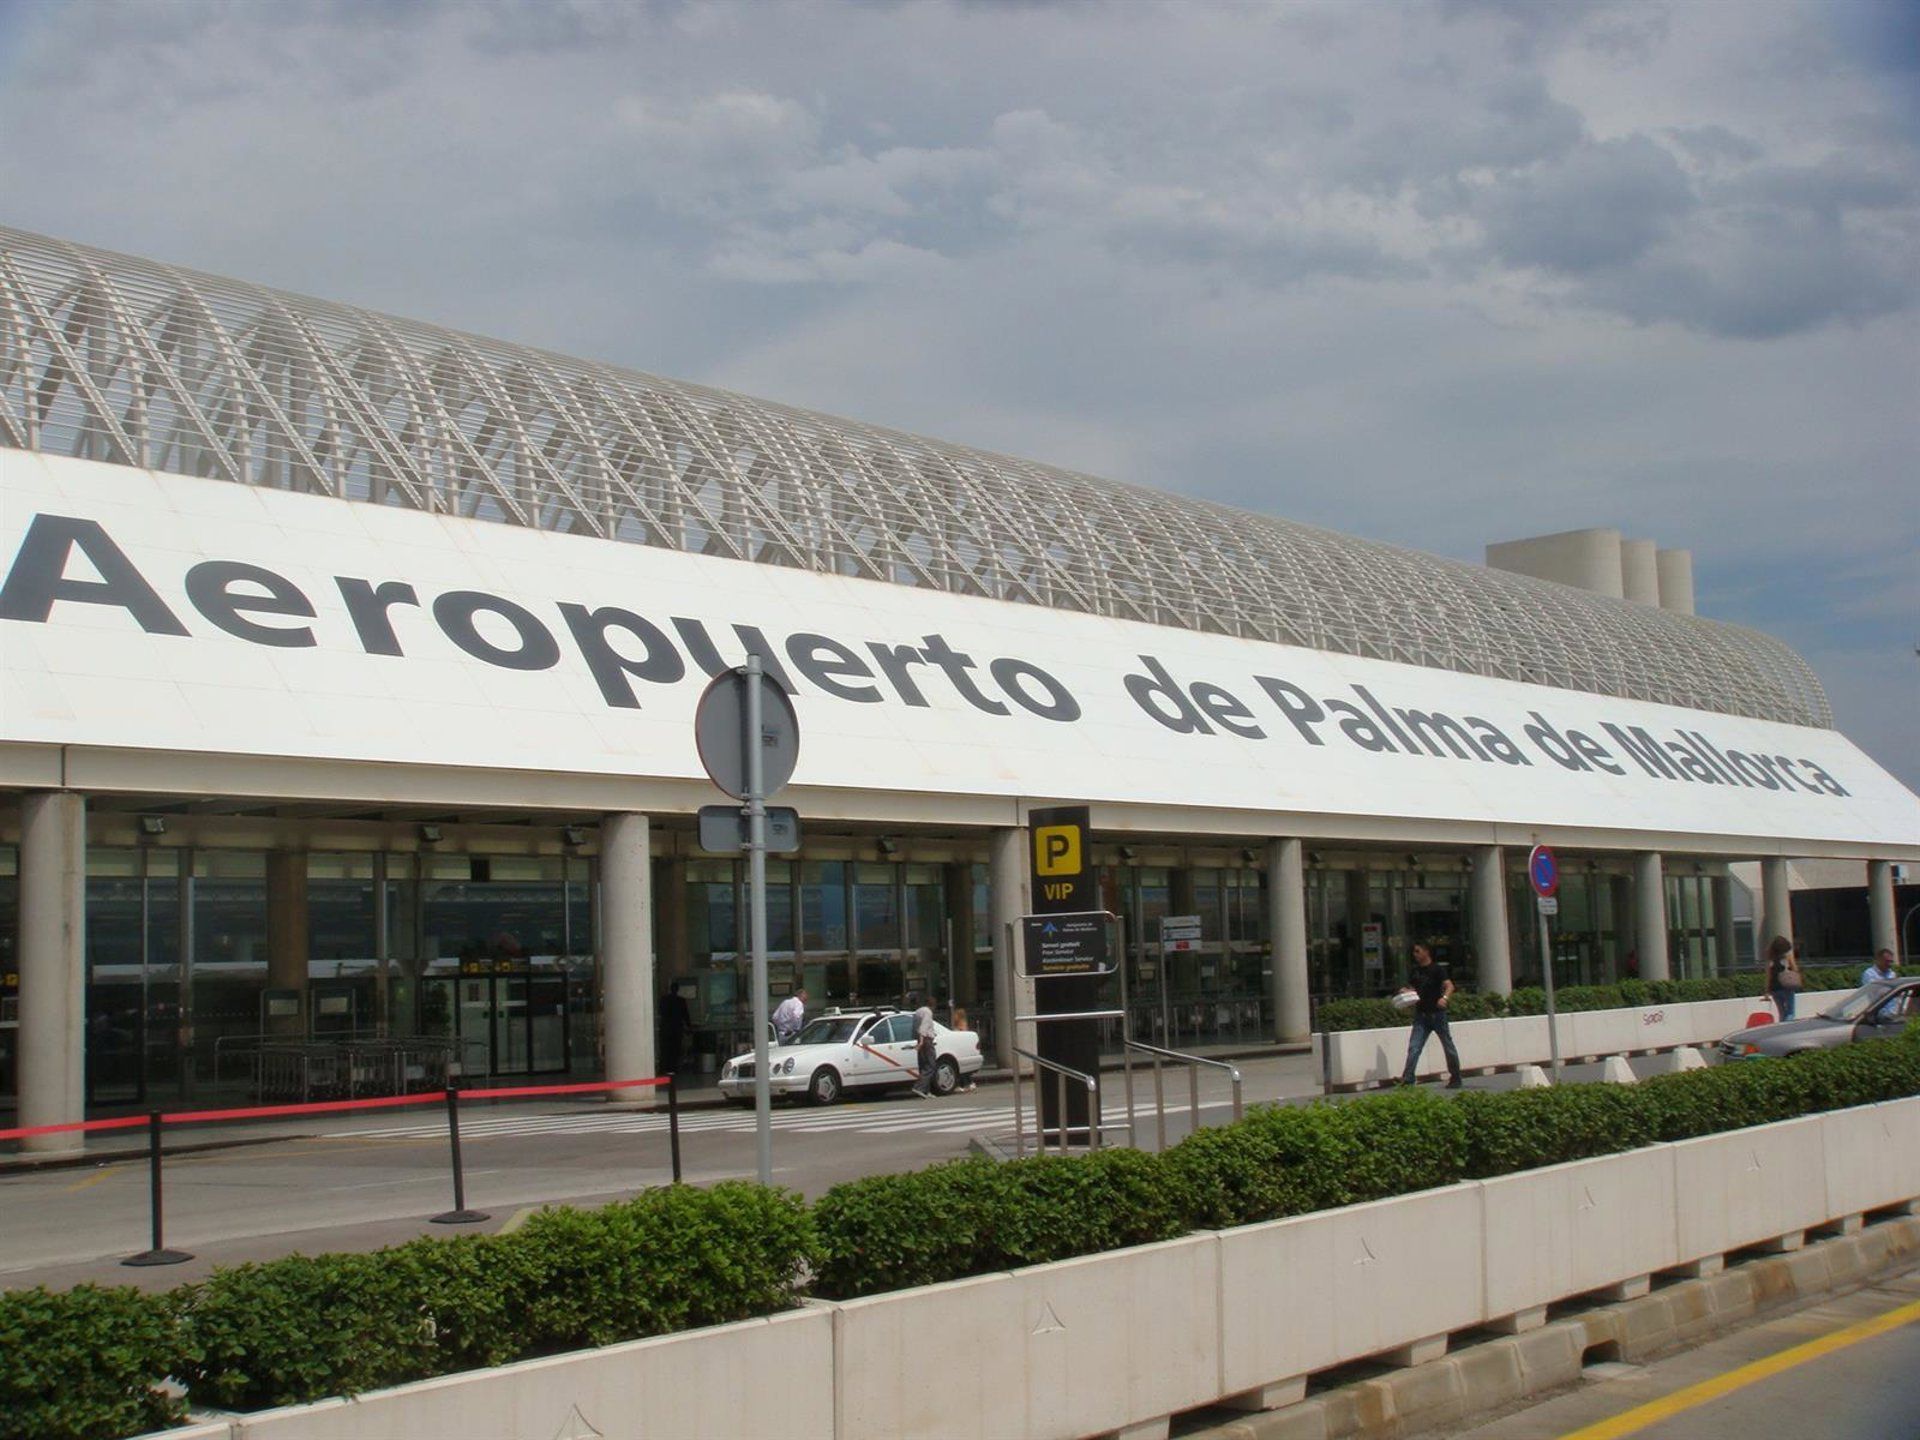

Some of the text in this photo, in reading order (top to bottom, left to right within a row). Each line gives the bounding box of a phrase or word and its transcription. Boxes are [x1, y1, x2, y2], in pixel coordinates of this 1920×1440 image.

[0, 512, 1853, 797] Aeropuerto de Palma de Mallorca
[1046, 834, 1070, 868] P
[1044, 883, 1074, 901] VIP
